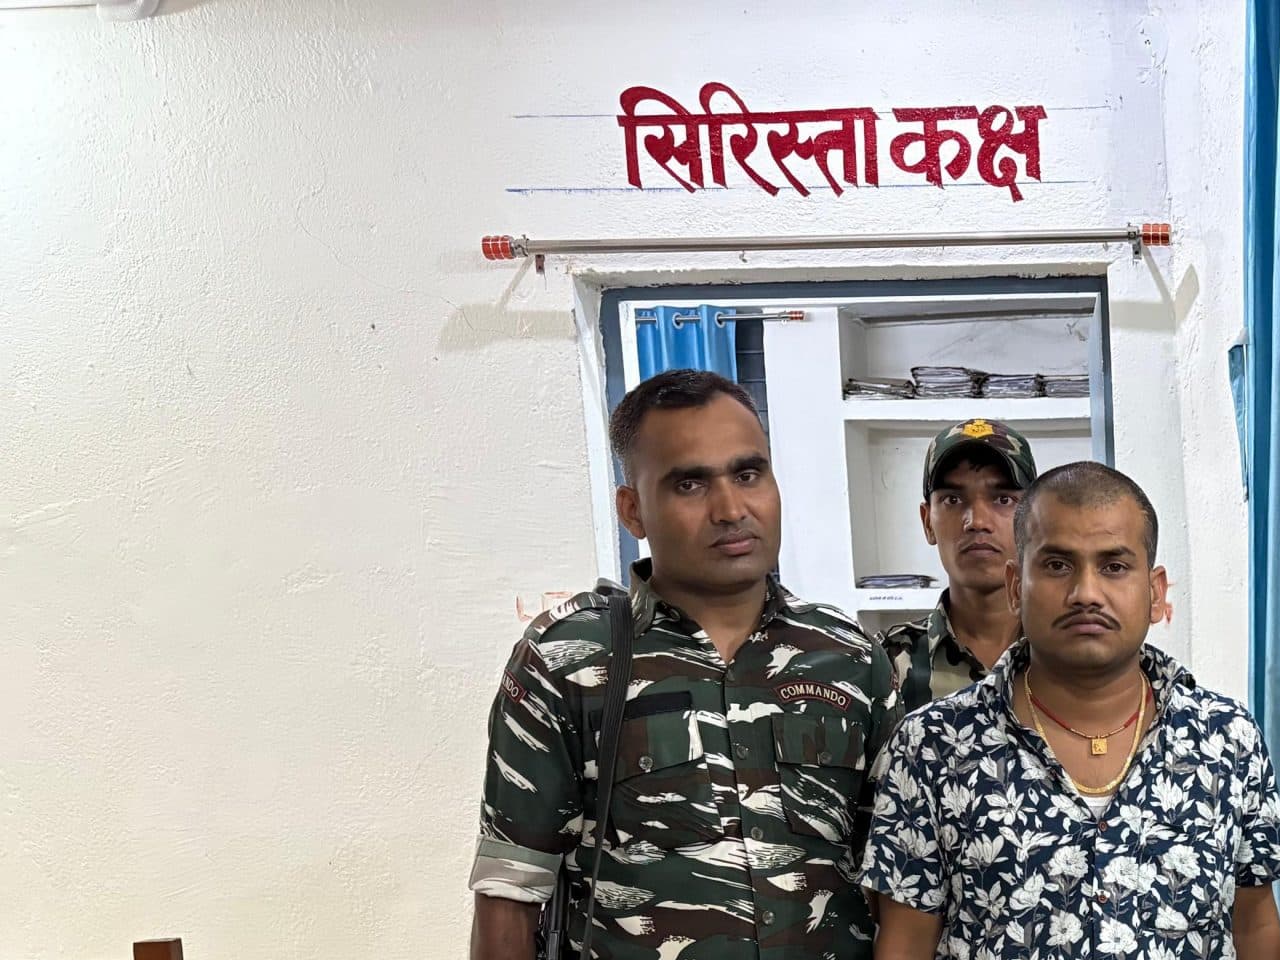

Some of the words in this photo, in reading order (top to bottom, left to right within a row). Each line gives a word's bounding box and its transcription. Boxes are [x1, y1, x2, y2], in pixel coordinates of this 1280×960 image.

[617, 82, 879, 197] सिरिस्ता
[890, 105, 1047, 202] कक्ष
[780, 684, 846, 706] COMMANDO
